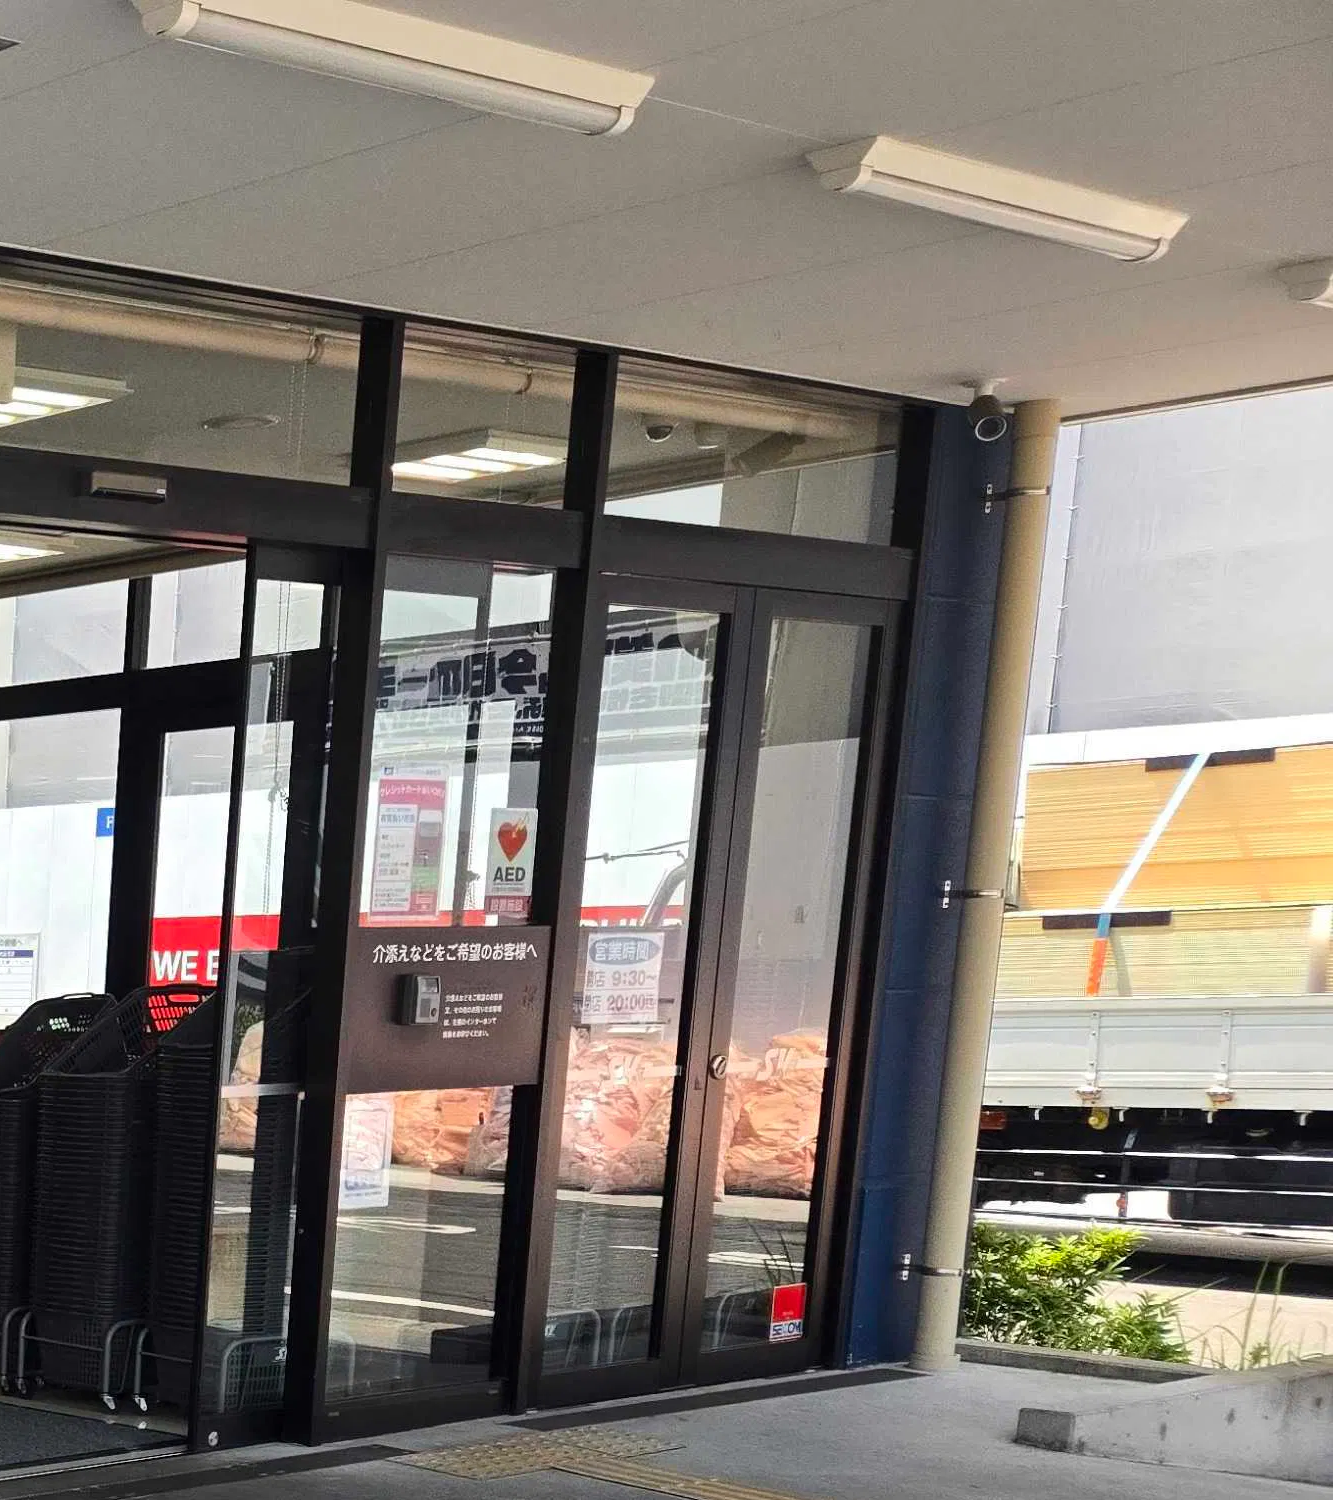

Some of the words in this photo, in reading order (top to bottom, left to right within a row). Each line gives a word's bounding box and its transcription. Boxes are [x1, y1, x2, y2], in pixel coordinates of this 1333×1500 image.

[493, 866, 526, 882] AED
[372, 943, 538, 964] 介添えなどをご希望のお客様へ
[595, 940, 650, 960] 営業時間
[153, 950, 198, 981] WE
